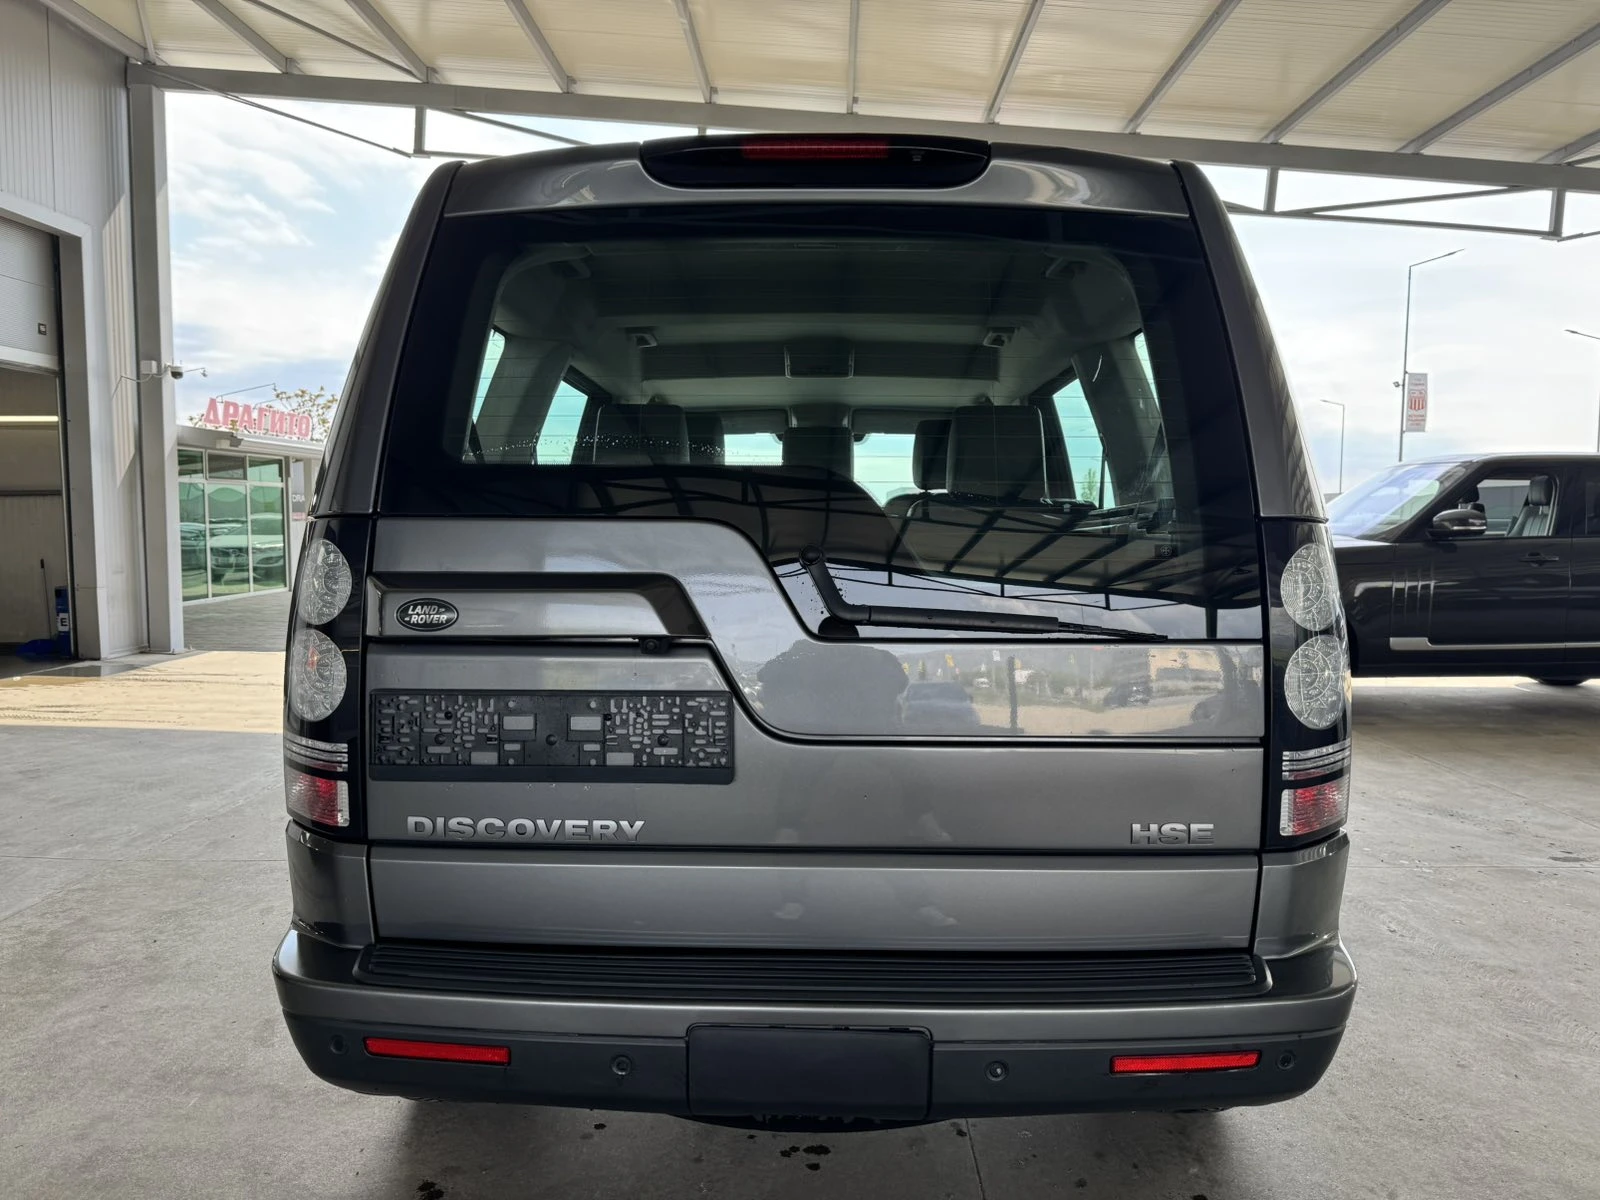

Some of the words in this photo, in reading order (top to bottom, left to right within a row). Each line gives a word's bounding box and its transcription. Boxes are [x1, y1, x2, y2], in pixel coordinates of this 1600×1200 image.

[408, 605, 438, 614] LAND
[410, 614, 447, 624] ROVER
[406, 815, 646, 842] DISCOVERY
[1130, 822, 1215, 845] HSE
